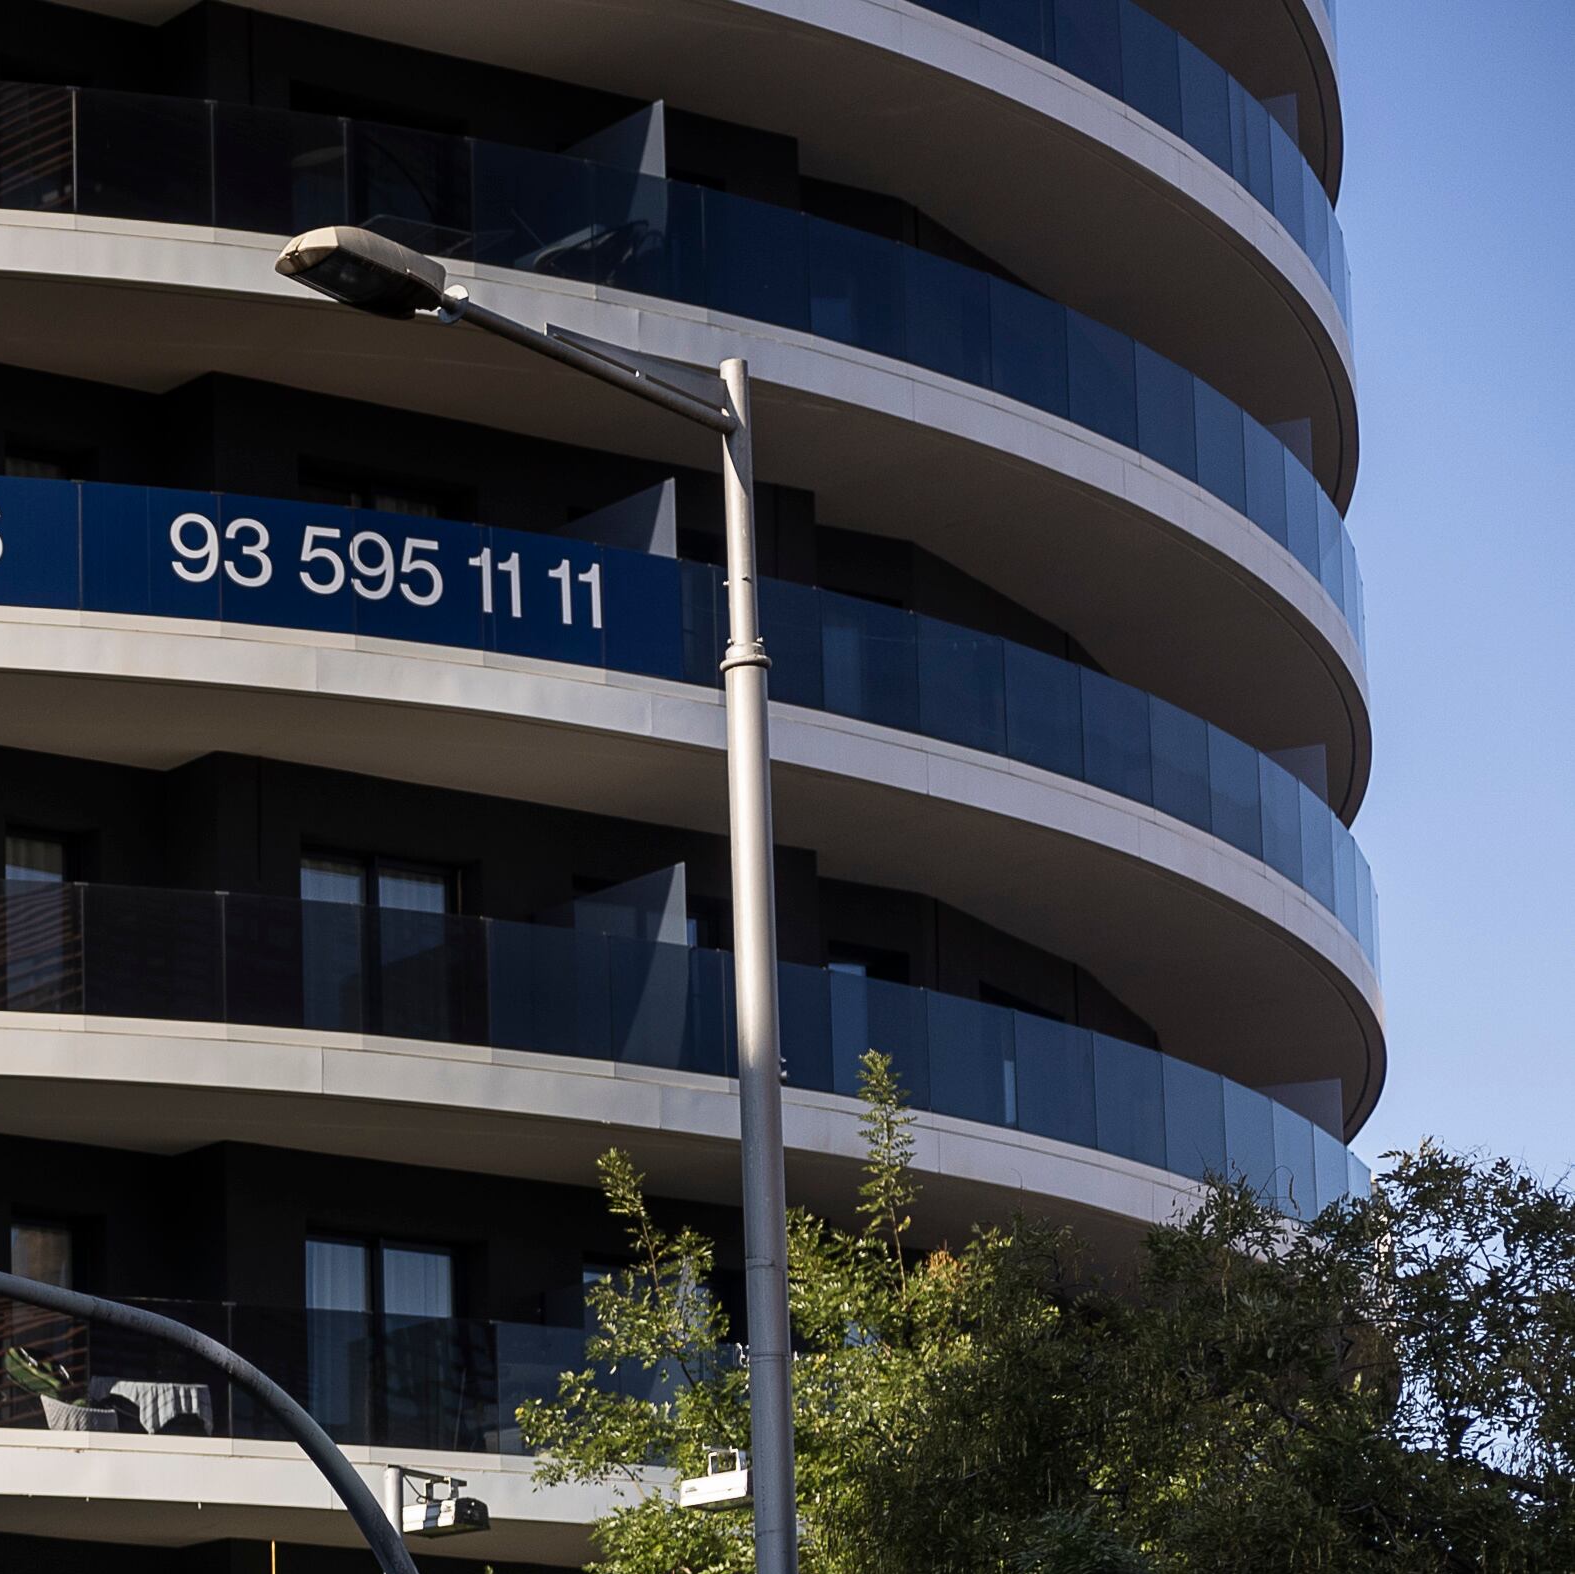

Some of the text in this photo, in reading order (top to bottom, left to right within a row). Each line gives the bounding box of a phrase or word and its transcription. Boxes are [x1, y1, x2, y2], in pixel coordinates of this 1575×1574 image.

[169, 512, 273, 588] 93
[299, 525, 444, 606] 595
[468, 547, 522, 618] 11
[548, 558, 602, 629] 11
